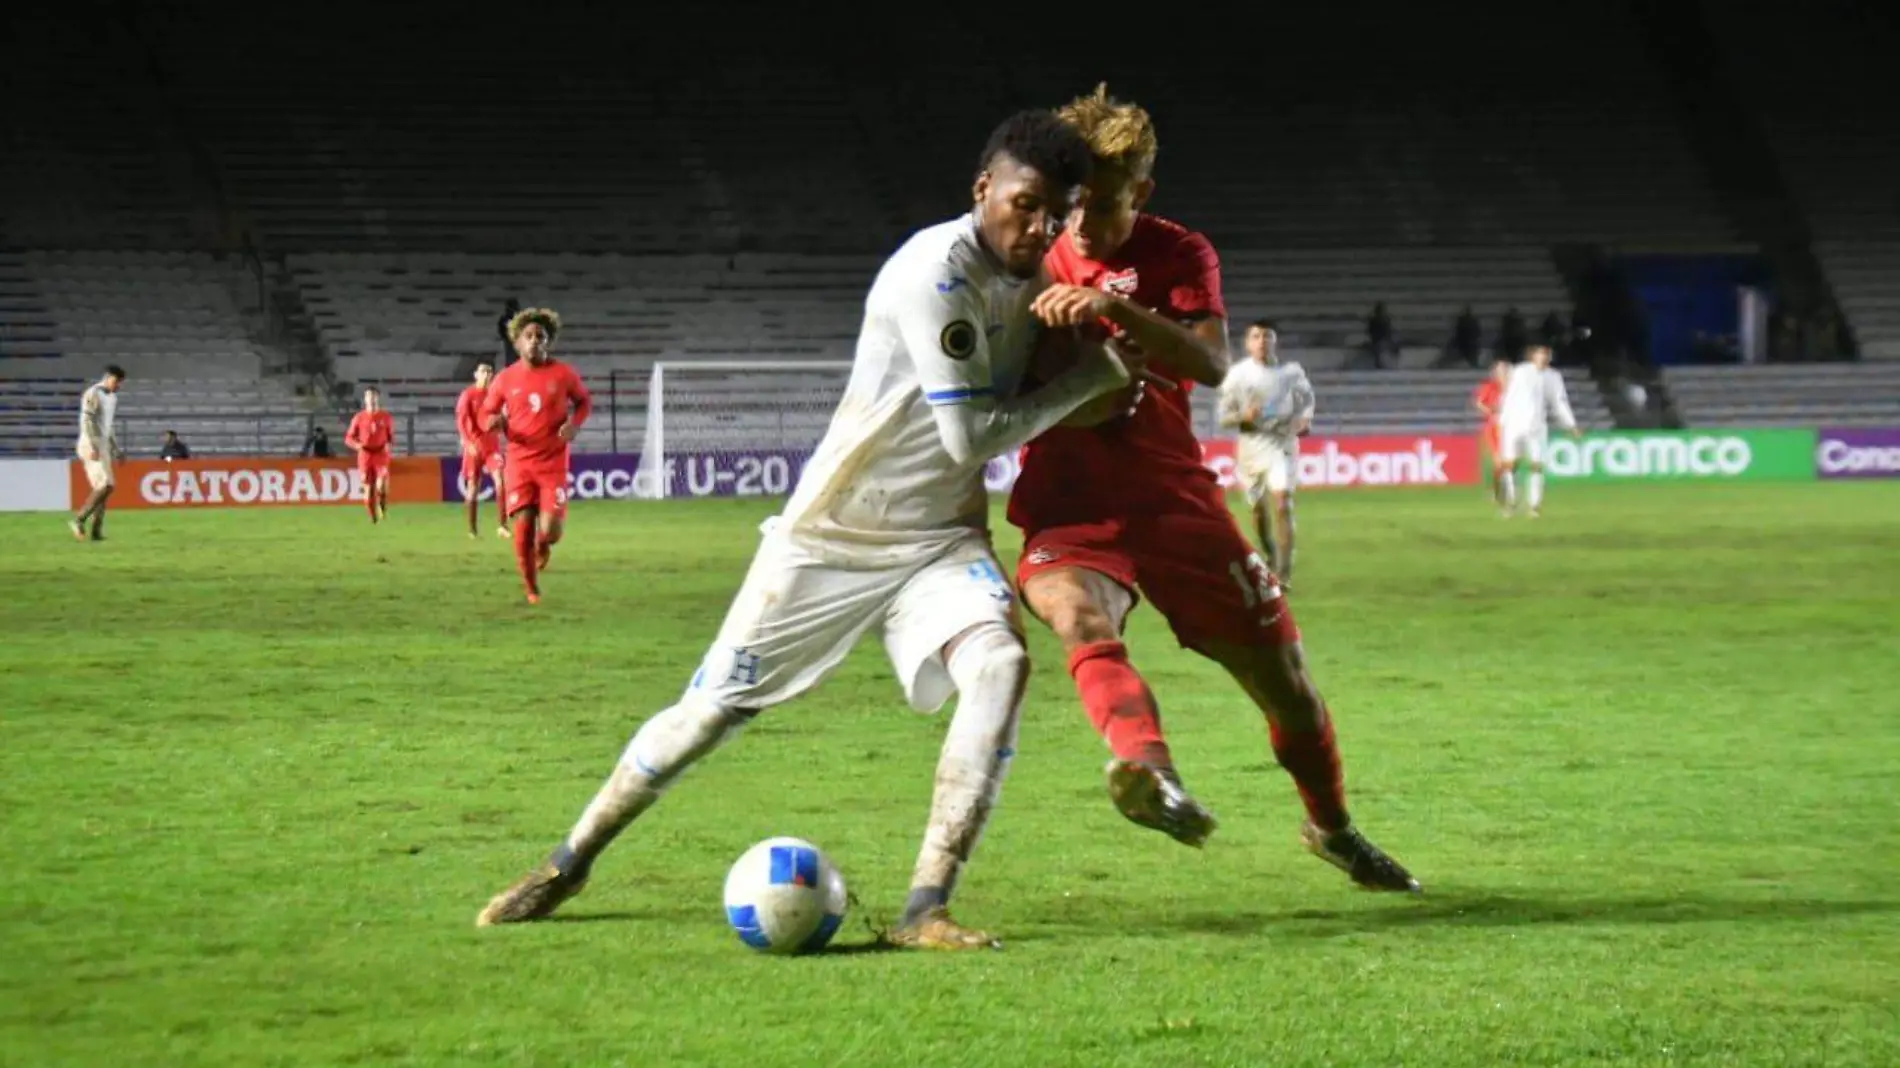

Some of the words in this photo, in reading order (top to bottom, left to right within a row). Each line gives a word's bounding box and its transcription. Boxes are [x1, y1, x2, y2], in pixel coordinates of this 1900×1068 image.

[528, 391, 542, 414] 9
[1546, 436, 1752, 475] aramco
[687, 456, 790, 495] U-20
